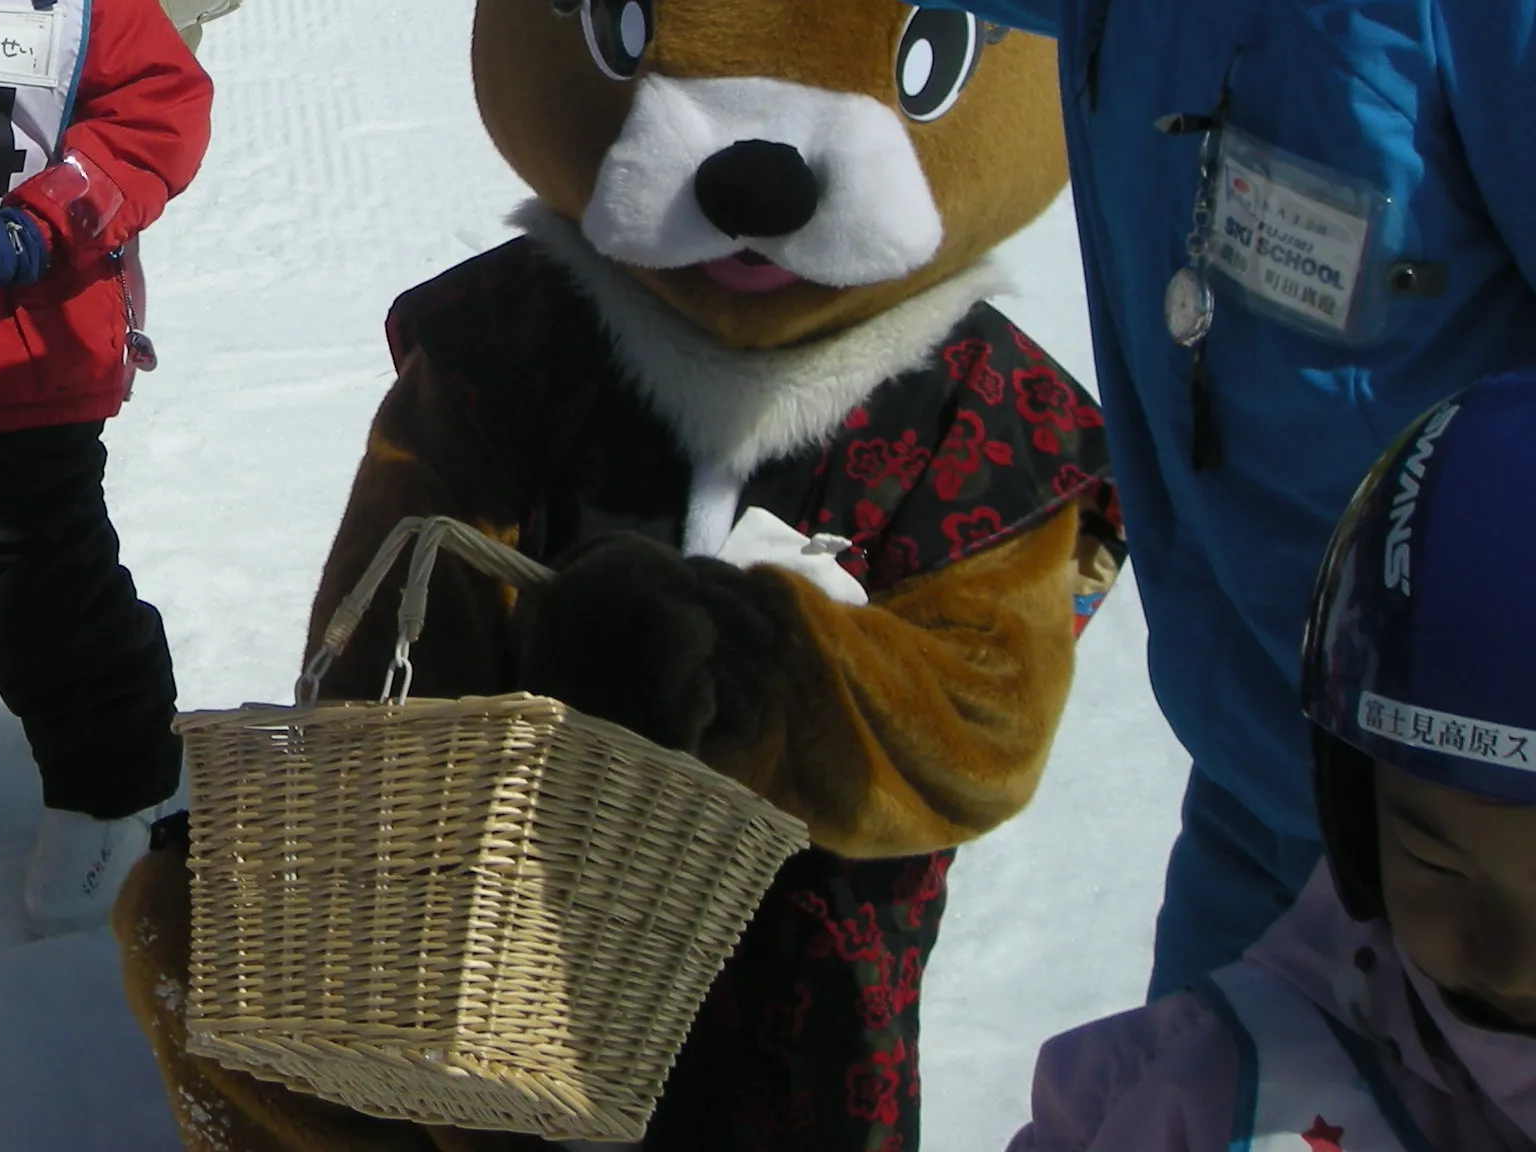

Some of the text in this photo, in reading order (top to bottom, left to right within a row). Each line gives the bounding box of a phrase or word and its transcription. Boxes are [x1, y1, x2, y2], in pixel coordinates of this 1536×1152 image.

[1225, 215, 1254, 248] SKI
[1256, 237, 1345, 291] SCHOOL
[1383, 403, 1460, 597] SWANS
